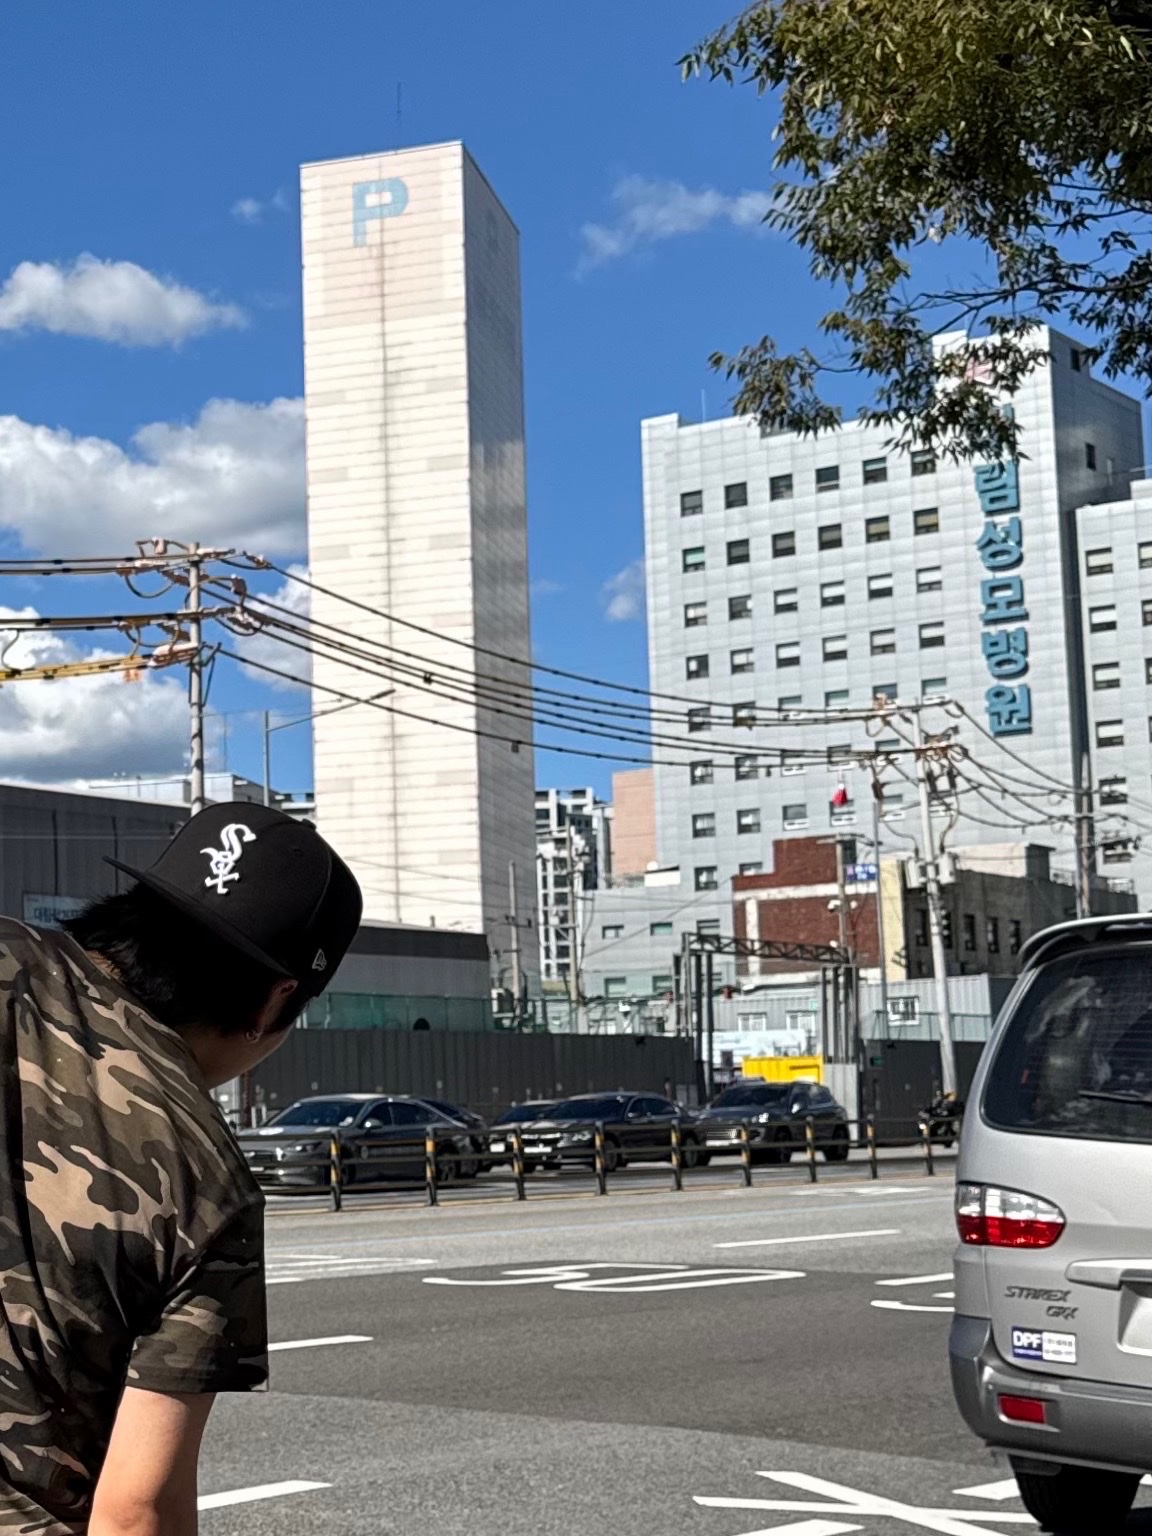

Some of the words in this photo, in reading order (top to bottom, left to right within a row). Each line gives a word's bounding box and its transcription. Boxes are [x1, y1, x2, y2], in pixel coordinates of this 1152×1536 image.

[352, 177, 410, 249] P
[975, 404, 1034, 736] 림성모병원
[1004, 1285, 1072, 1303] STAREX
[1012, 1330, 1042, 1349] DPF
